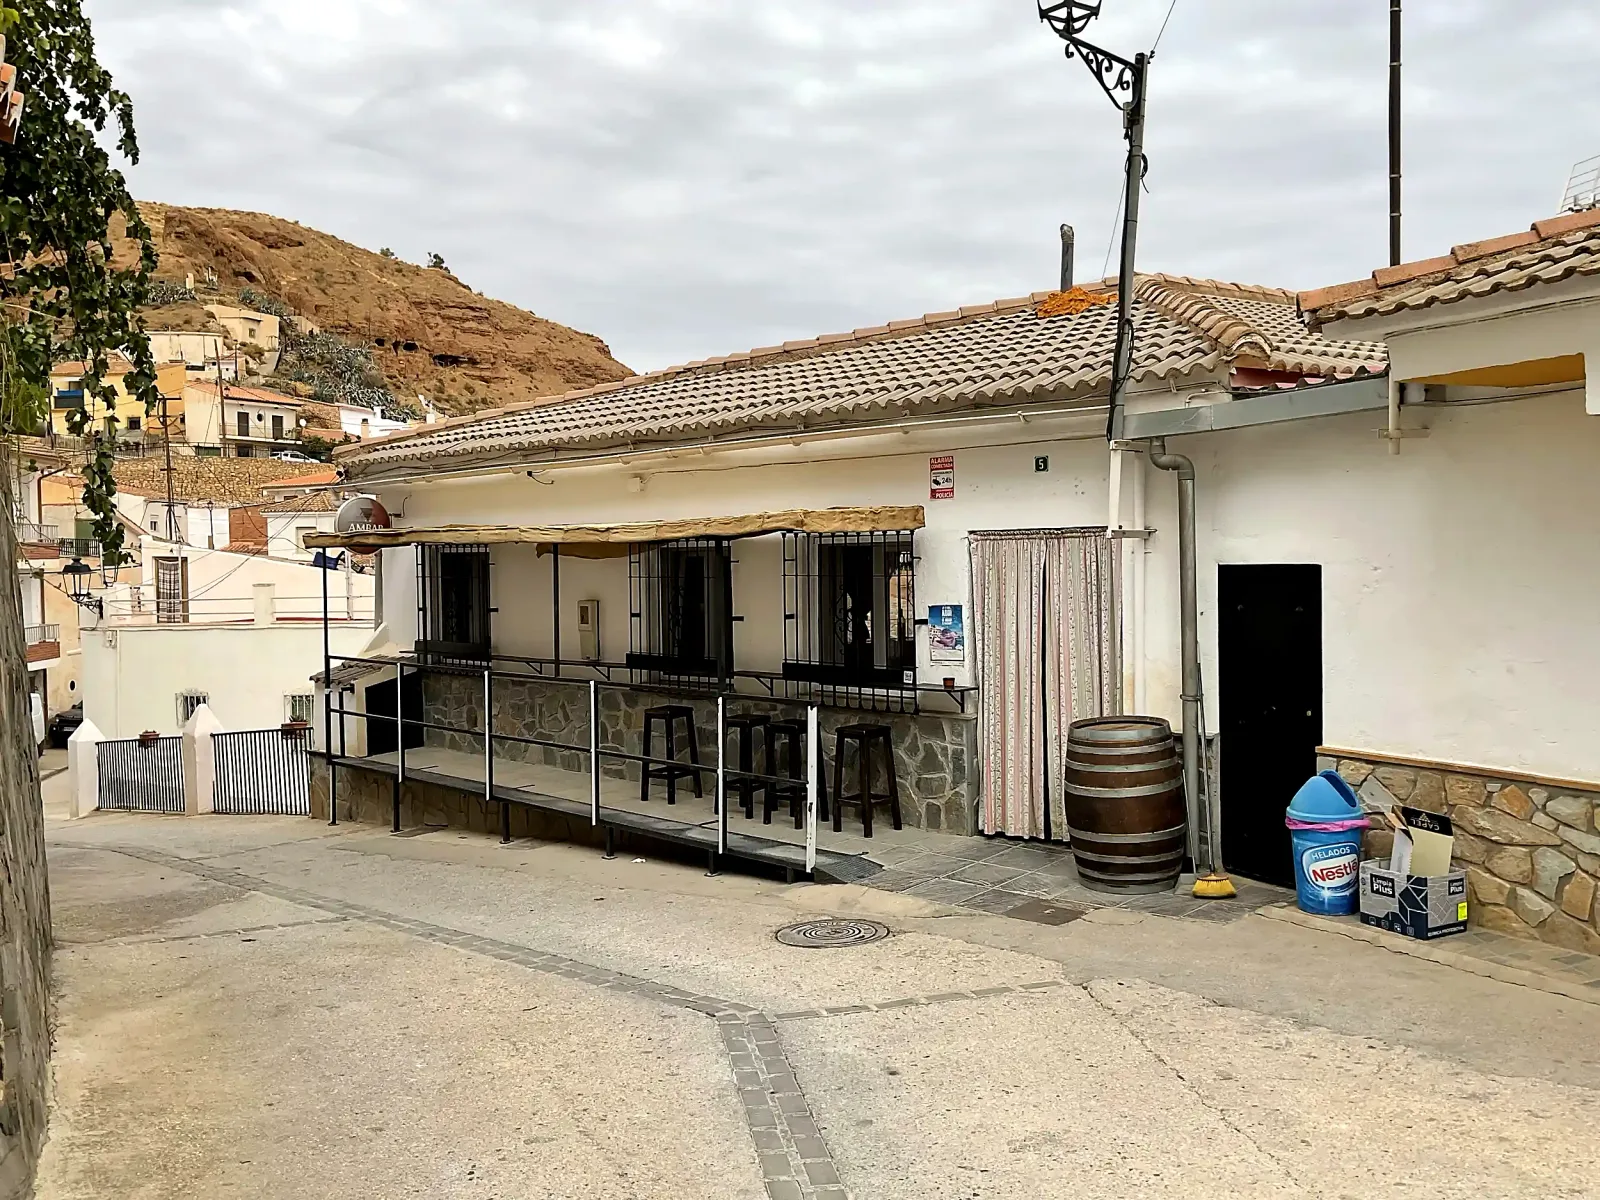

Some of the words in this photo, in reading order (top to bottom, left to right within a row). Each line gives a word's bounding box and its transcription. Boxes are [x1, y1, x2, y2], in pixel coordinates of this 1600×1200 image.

[1038, 459, 1044, 470] 5
[1311, 846, 1351, 860] HELADOS
[1312, 858, 1358, 882] Nestlé
[1372, 876, 1393, 887] Limpia
[1373, 883, 1393, 895] Plus
[1450, 886, 1463, 894] Plus
